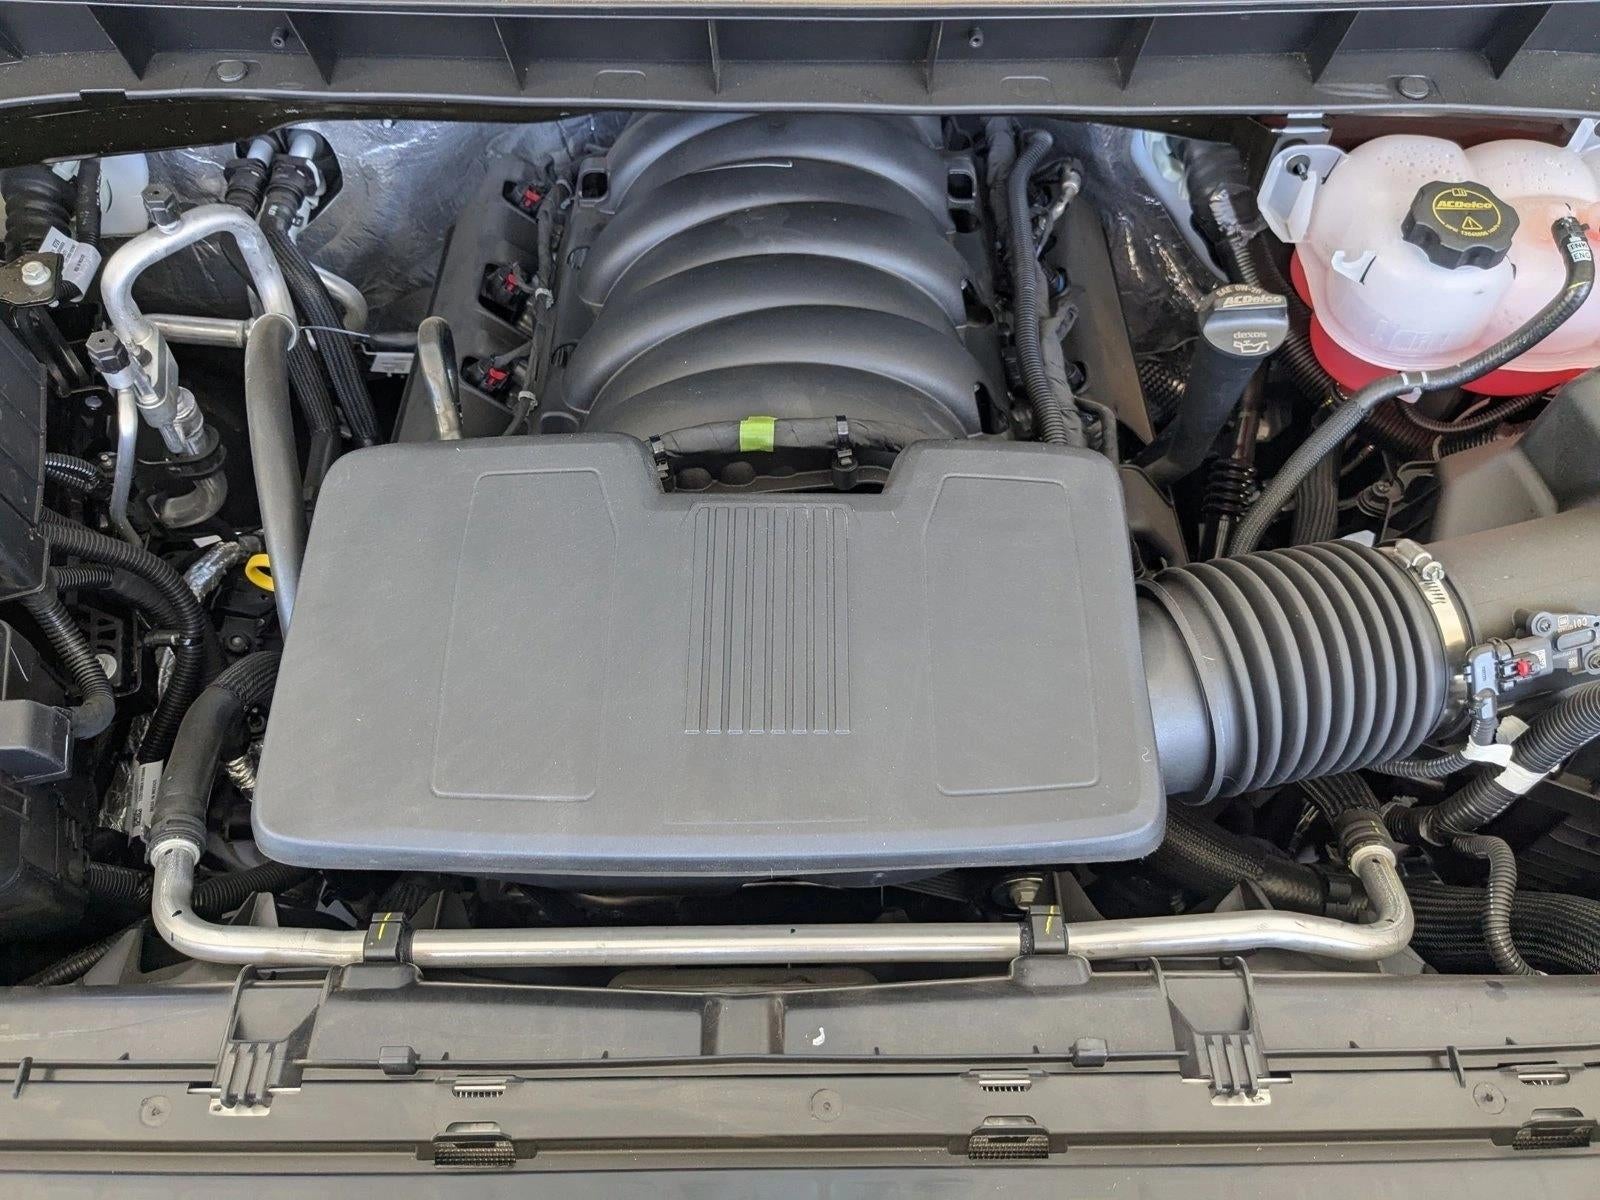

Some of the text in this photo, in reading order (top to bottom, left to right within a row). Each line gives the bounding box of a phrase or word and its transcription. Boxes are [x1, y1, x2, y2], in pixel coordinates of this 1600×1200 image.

[1436, 200, 1493, 210] ACDelco
[1216, 286, 1232, 297] SAE
[1223, 294, 1283, 305] ACDelco
[1233, 331, 1267, 339] dexos
